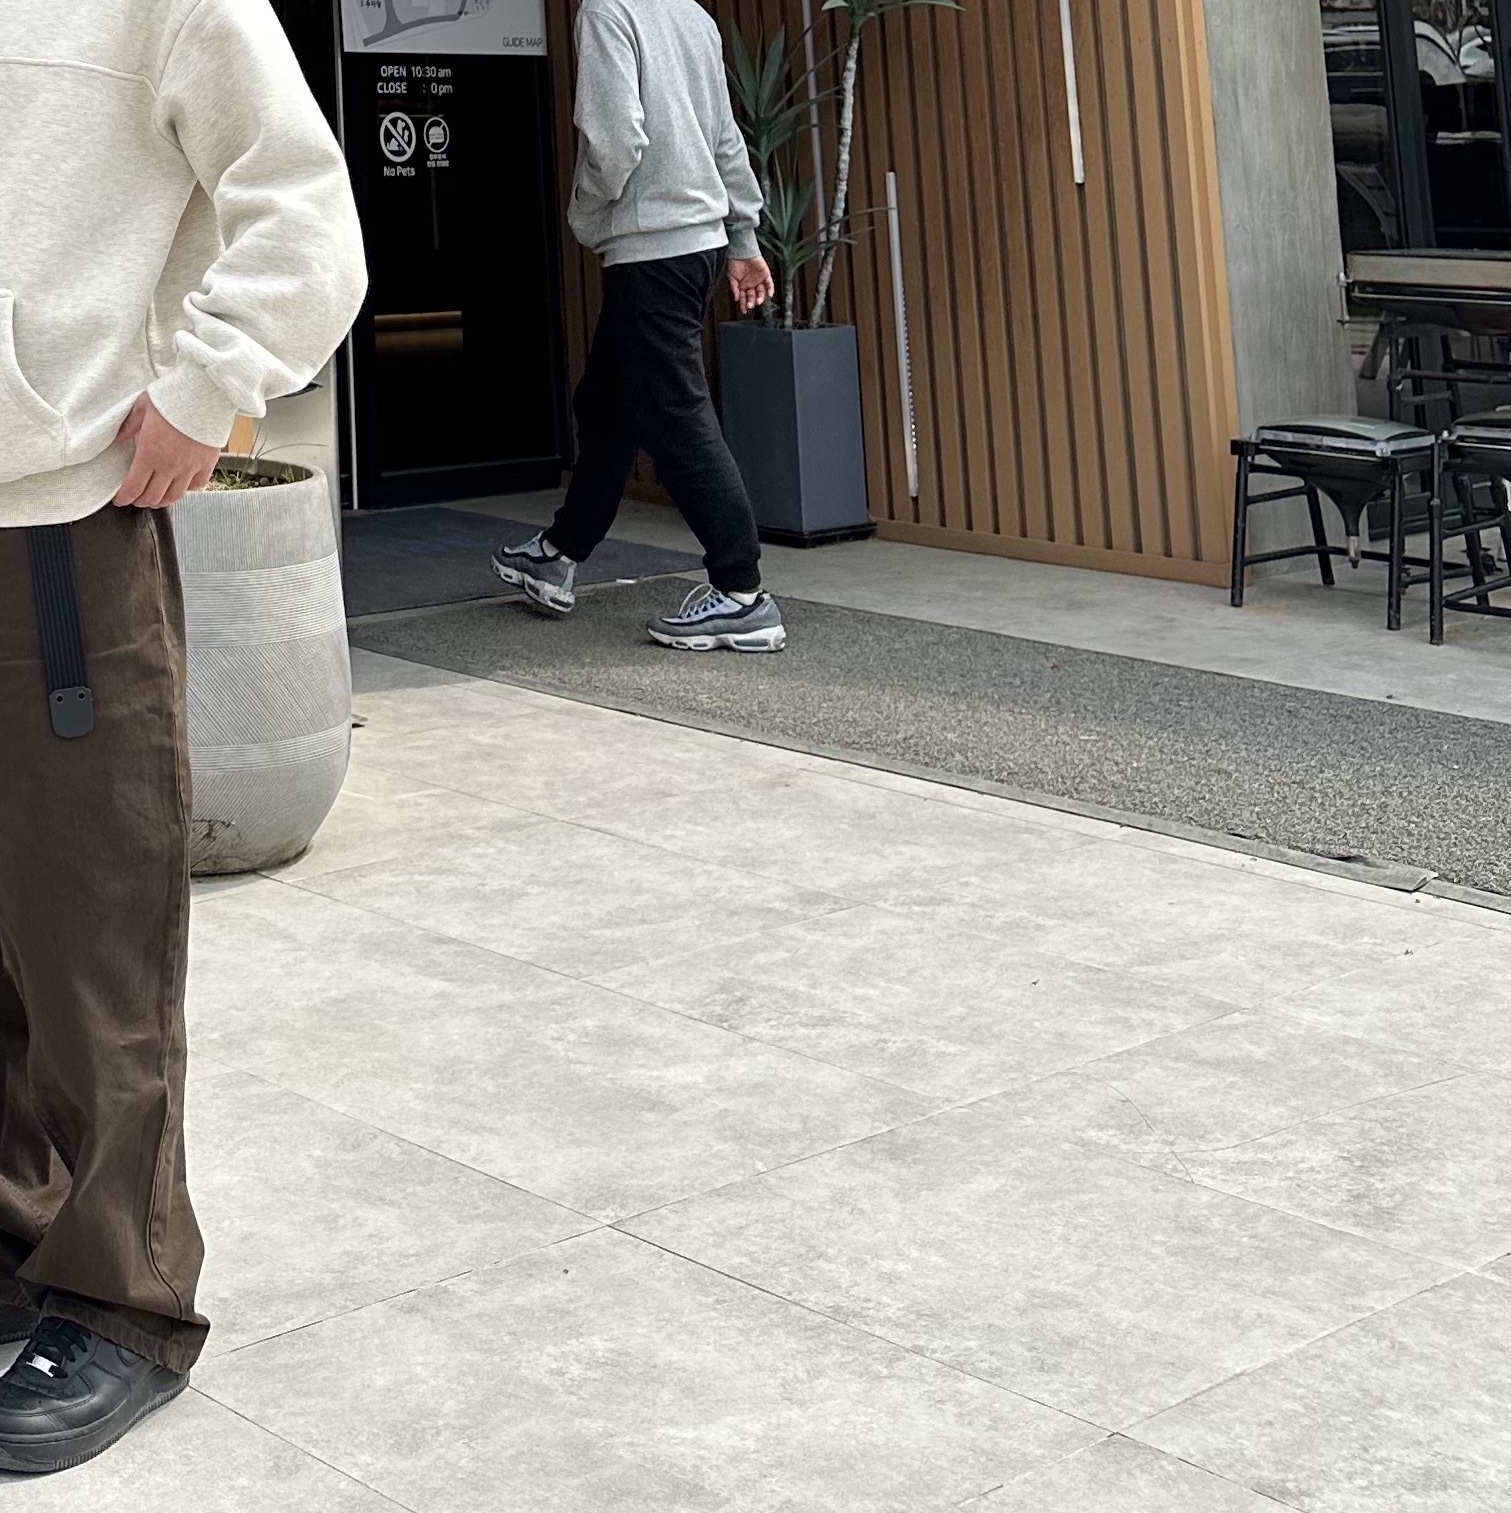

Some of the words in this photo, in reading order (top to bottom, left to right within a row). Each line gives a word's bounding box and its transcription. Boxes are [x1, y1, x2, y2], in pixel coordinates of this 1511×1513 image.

[502, 37, 525, 48] GUIDE
[526, 37, 543, 48] MAP
[380, 65, 407, 78] OPEN
[411, 65, 437, 78] 10:30
[437, 67, 452, 78] am
[377, 81, 408, 94] CLOSE
[438, 84, 453, 97] pm
[383, 166, 396, 177] No
[396, 166, 416, 177] Pets
